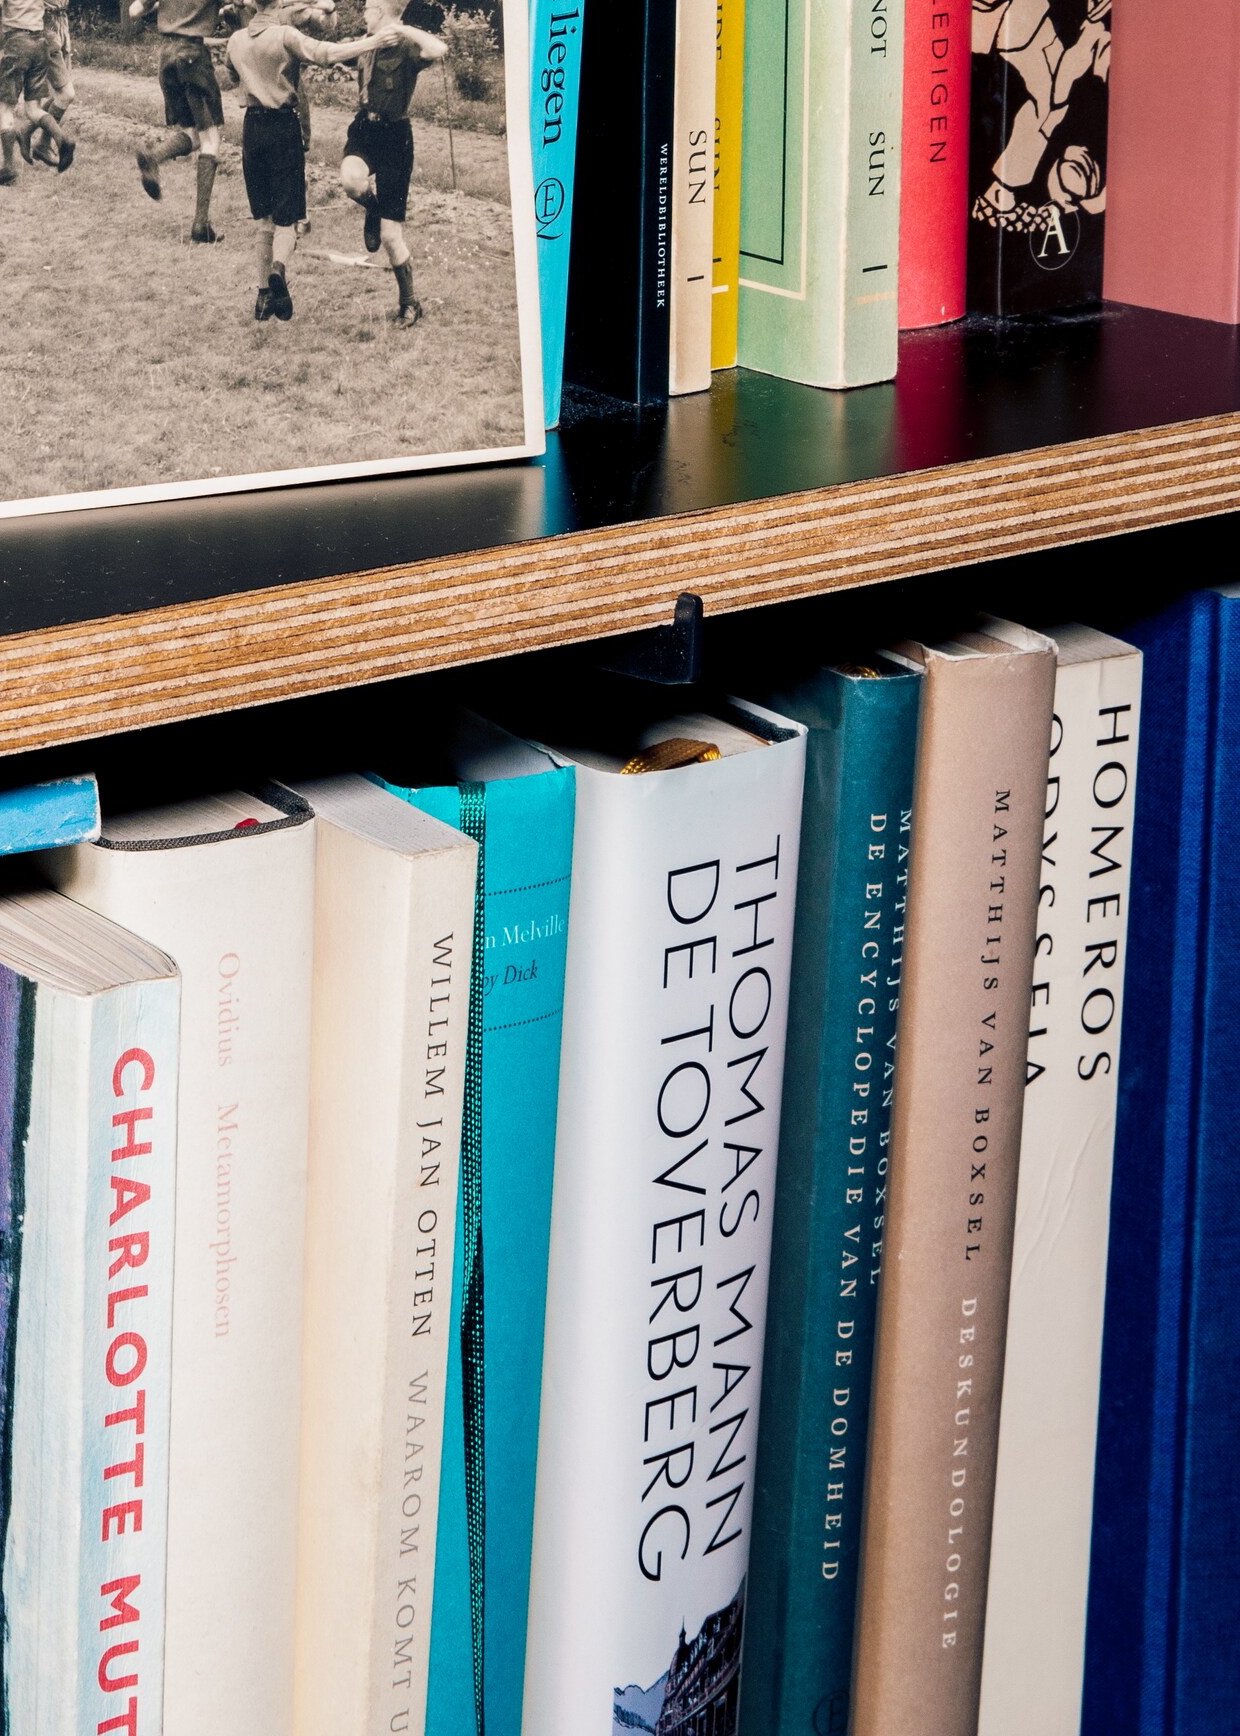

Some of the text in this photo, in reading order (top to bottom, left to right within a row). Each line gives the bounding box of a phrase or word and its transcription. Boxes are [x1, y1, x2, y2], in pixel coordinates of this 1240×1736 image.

[539, 8, 580, 148] liegen
[688, 129, 708, 207] SUN
[868, 129, 887, 199] SUN
[655, 144, 669, 310] WERELDBIBLIOTHEEK
[502, 913, 566, 948] Melville
[503, 958, 539, 986] Dick
[1077, 703, 1133, 1082] HOMEROS
[214, 951, 241, 1340] Ovidius Metamorphosen
[702, 833, 781, 1558] THOMAS MANN
[821, 812, 888, 1582] DE ENCYCLOPEDIE VAN DE DOMHEID
[880, 1031, 898, 1108] VAN
[100, 1048, 155, 1544] CHARLOTTE
[392, 931, 455, 1689] WILLEM JAN OTTEN WAAROM KOMT
[637, 858, 722, 1583] DE TOVERBERG
[869, 1129, 892, 1286] BOXSEL
[941, 788, 1011, 1651] MATTHIJS VAN BOXSEL DESKUNDOLOGIE
